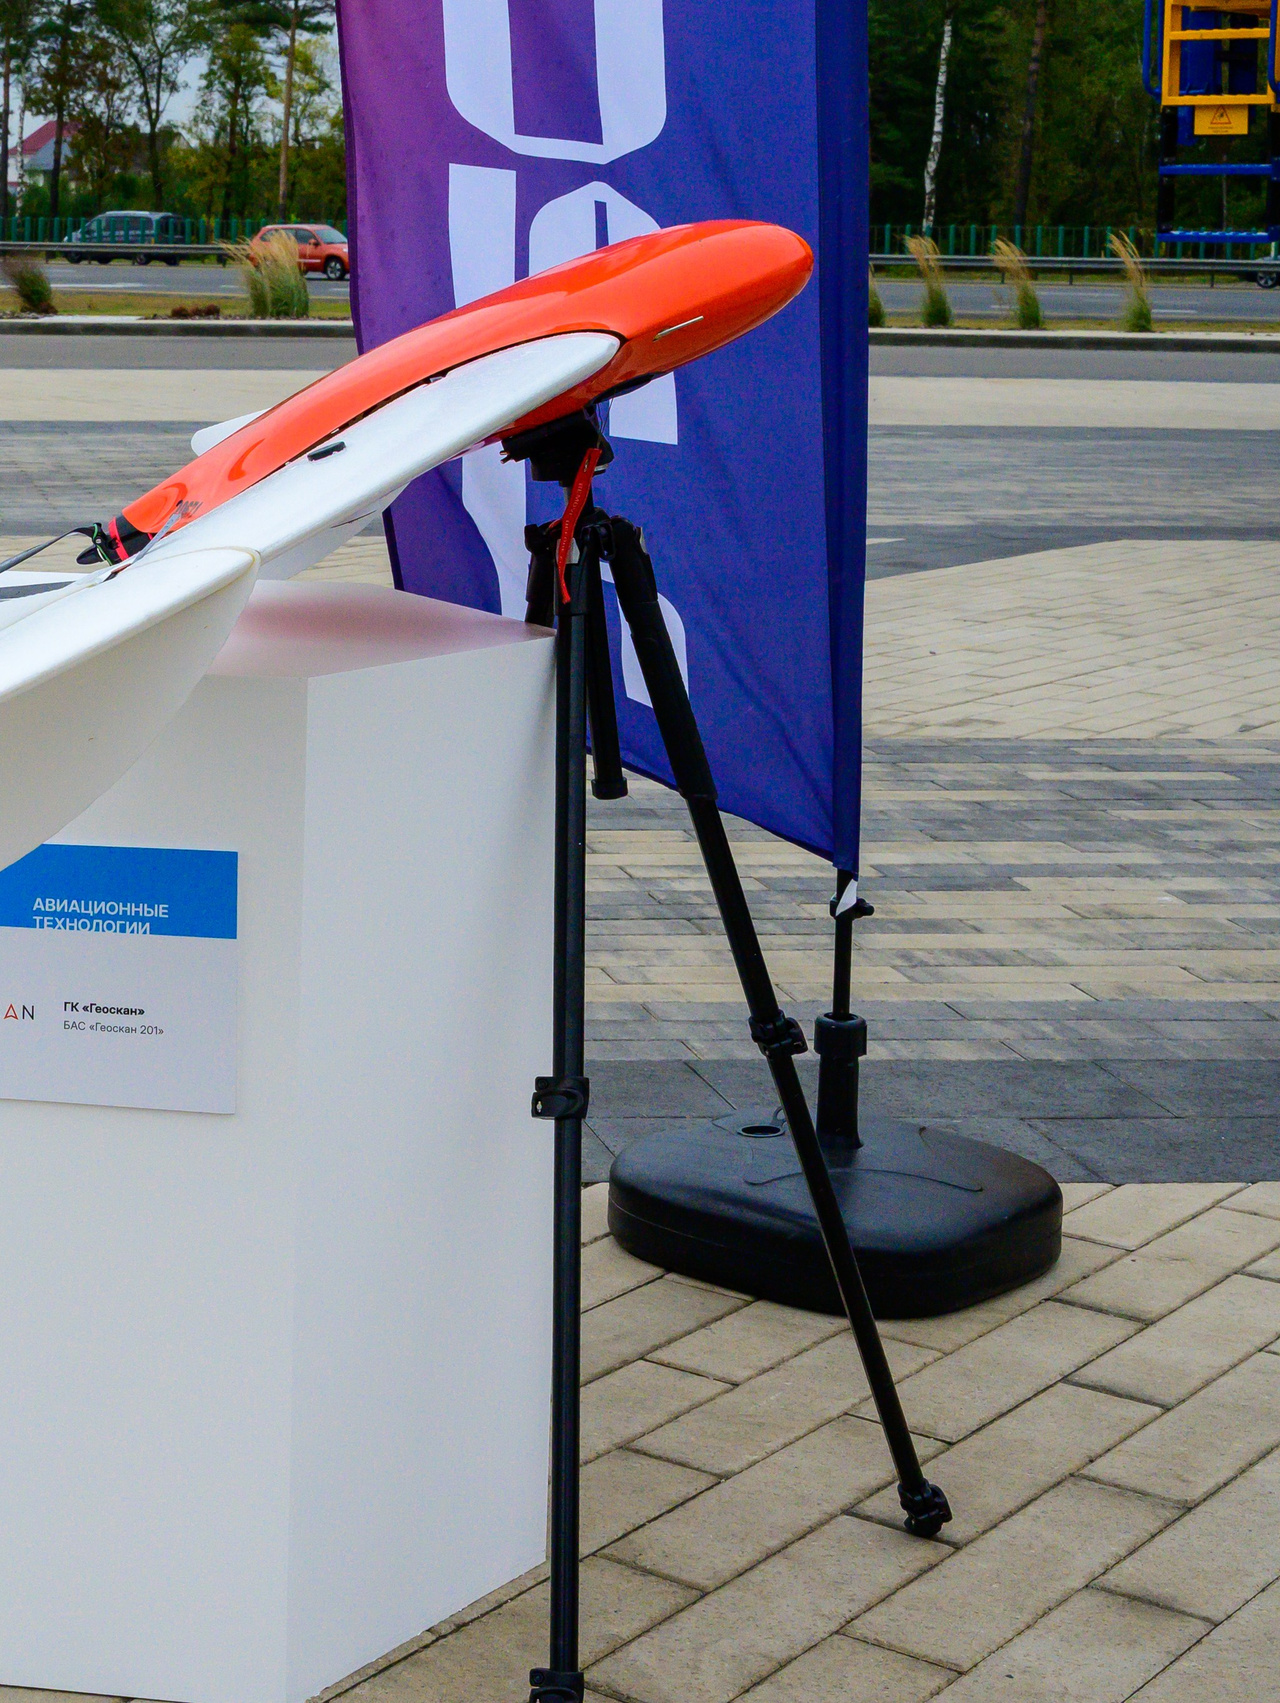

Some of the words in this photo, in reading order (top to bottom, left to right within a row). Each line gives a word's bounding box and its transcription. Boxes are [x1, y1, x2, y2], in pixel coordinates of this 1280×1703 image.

[32, 897, 169, 918] АВИАЦИОННЫЕ
[33, 915, 150, 935] ТЕХНОЛОГИИ
[63, 1001, 80, 1014] ГК
[82, 1003, 145, 1017] «Геоскан»
[63, 1020, 86, 1032] БАС
[89, 1022, 138, 1034] «Геоскан
[140, 1024, 164, 1036] 201»
